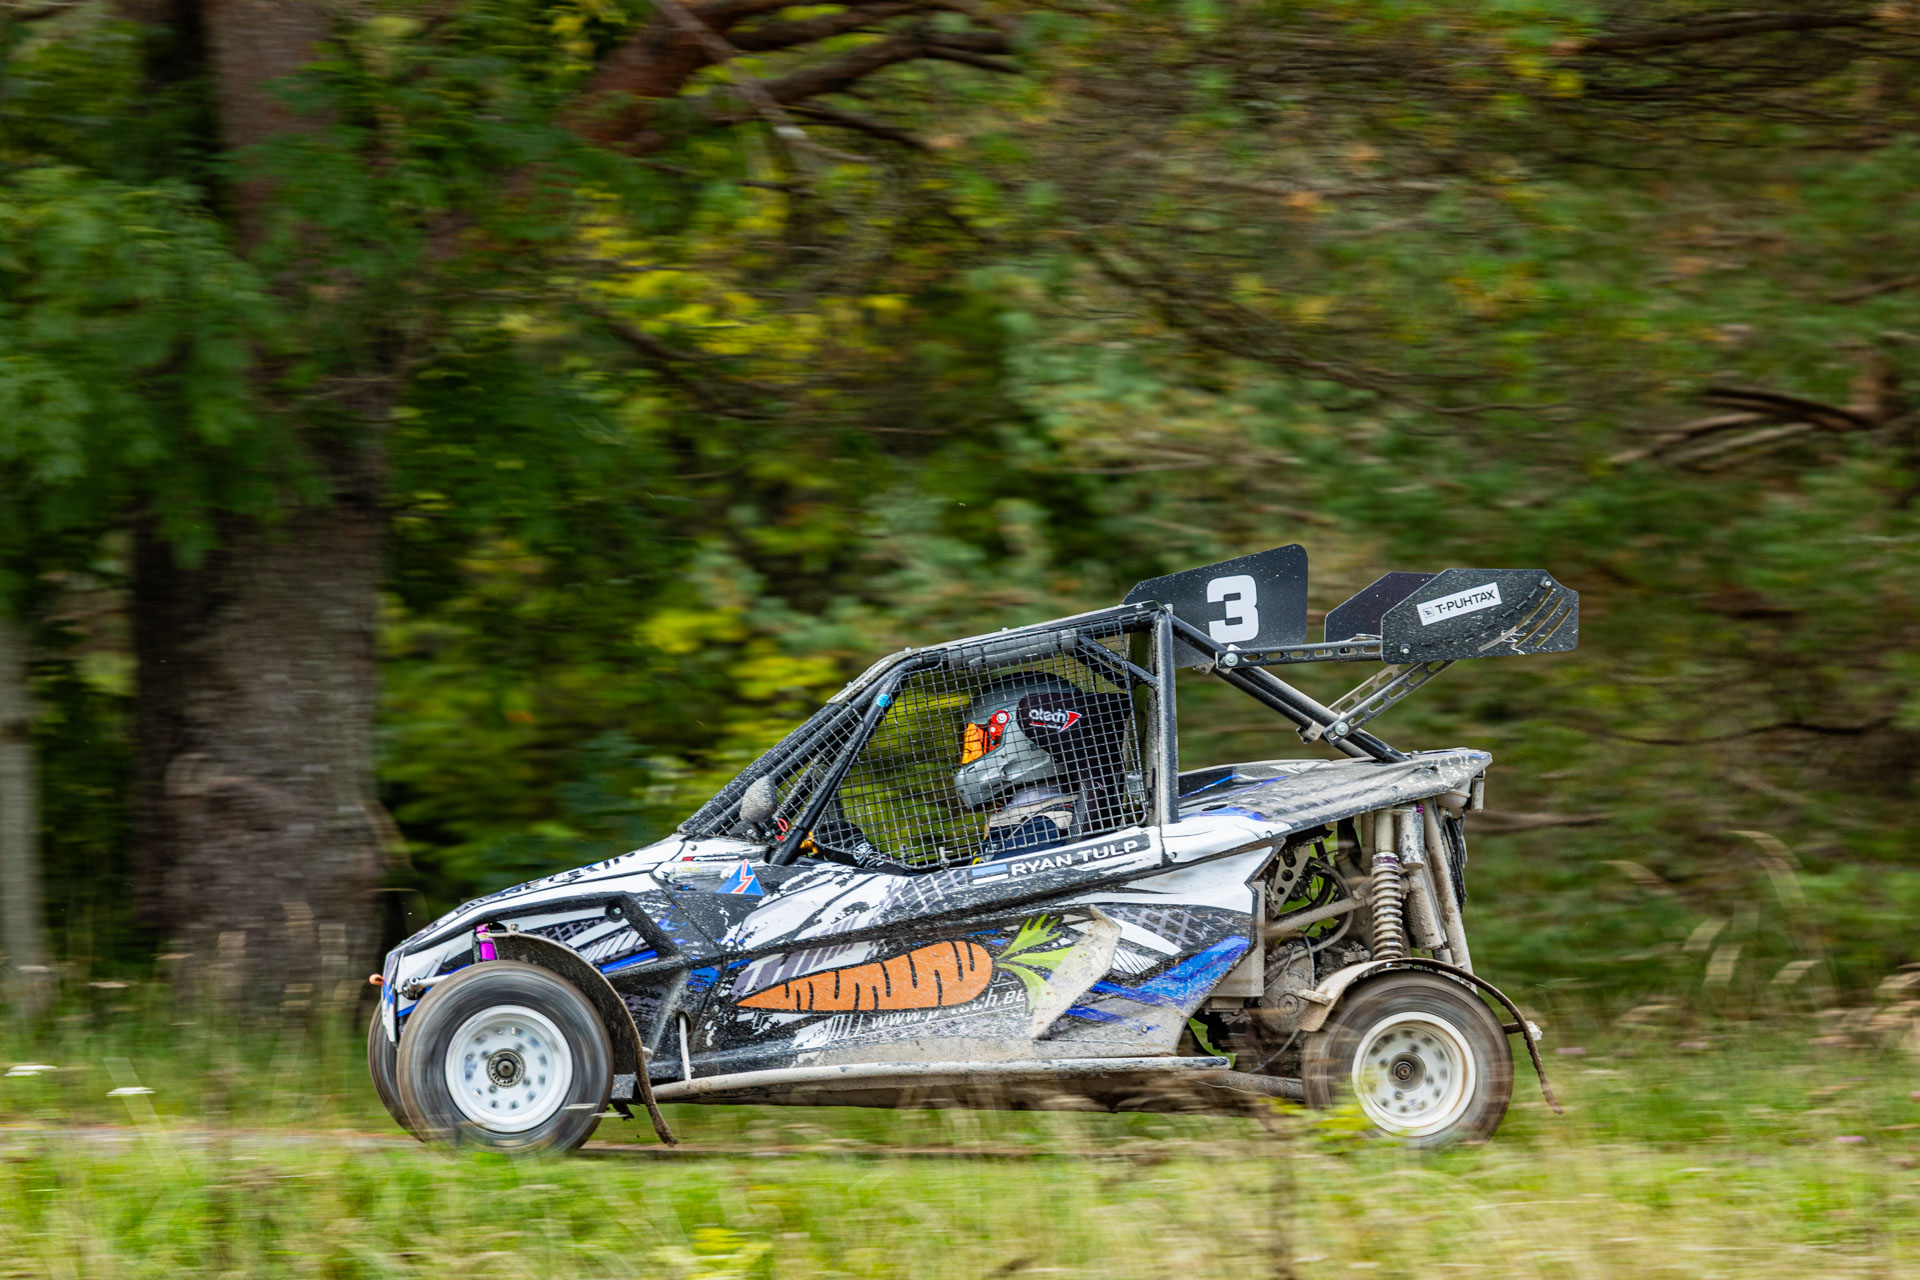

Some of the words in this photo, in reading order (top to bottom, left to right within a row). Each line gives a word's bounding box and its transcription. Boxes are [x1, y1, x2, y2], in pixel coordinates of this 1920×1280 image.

[1206, 574, 1259, 643] 3
[1435, 589, 1496, 614] T-PUHTAX
[1010, 853, 1073, 876] RYAN
[1077, 840, 1138, 862] TULP
[871, 988, 1026, 1030] www.ph.ee
